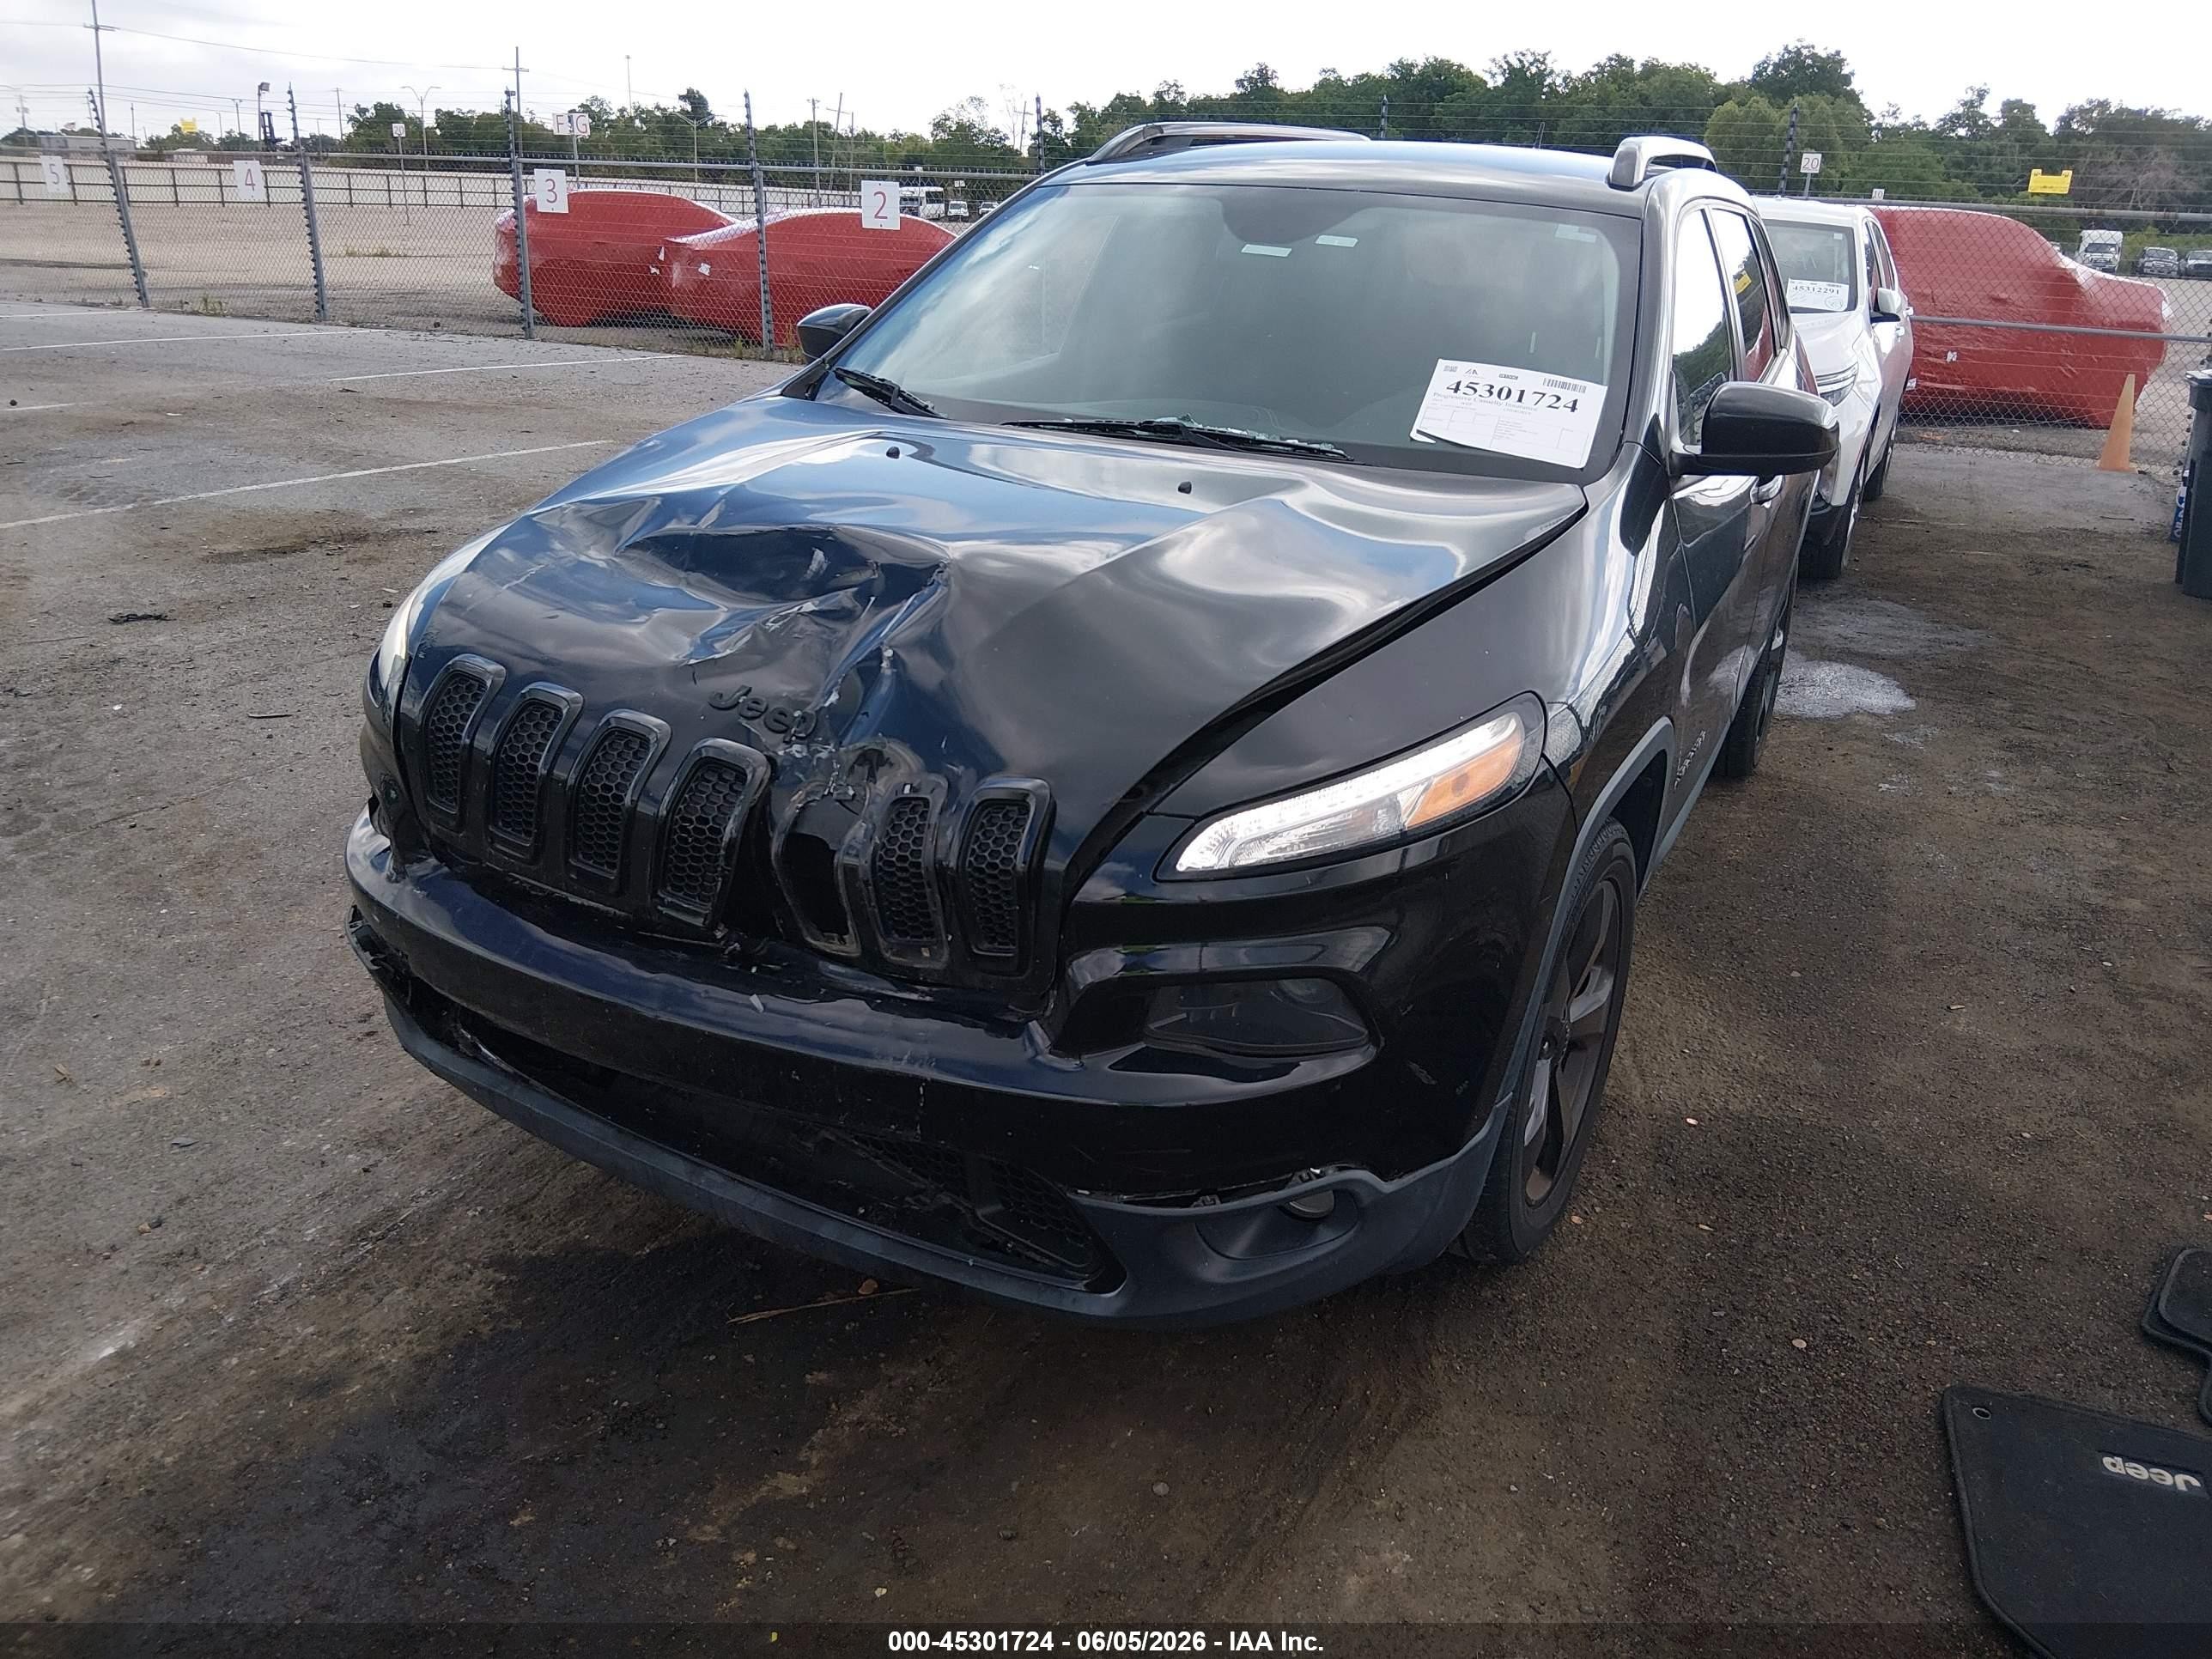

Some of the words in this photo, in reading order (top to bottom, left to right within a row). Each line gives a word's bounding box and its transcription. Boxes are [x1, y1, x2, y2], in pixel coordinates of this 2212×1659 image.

[556, 115, 565, 132] F
[575, 115, 589, 134] G
[49, 162, 60, 185] 5
[1802, 157, 1820, 169] 20
[244, 167, 256, 191] 4
[544, 178, 558, 204] 3
[873, 191, 888, 220] 2
[1445, 380, 1580, 413] 45301724
[708, 684, 817, 744] Jeep
[2102, 1455, 2202, 1492] Jeep
